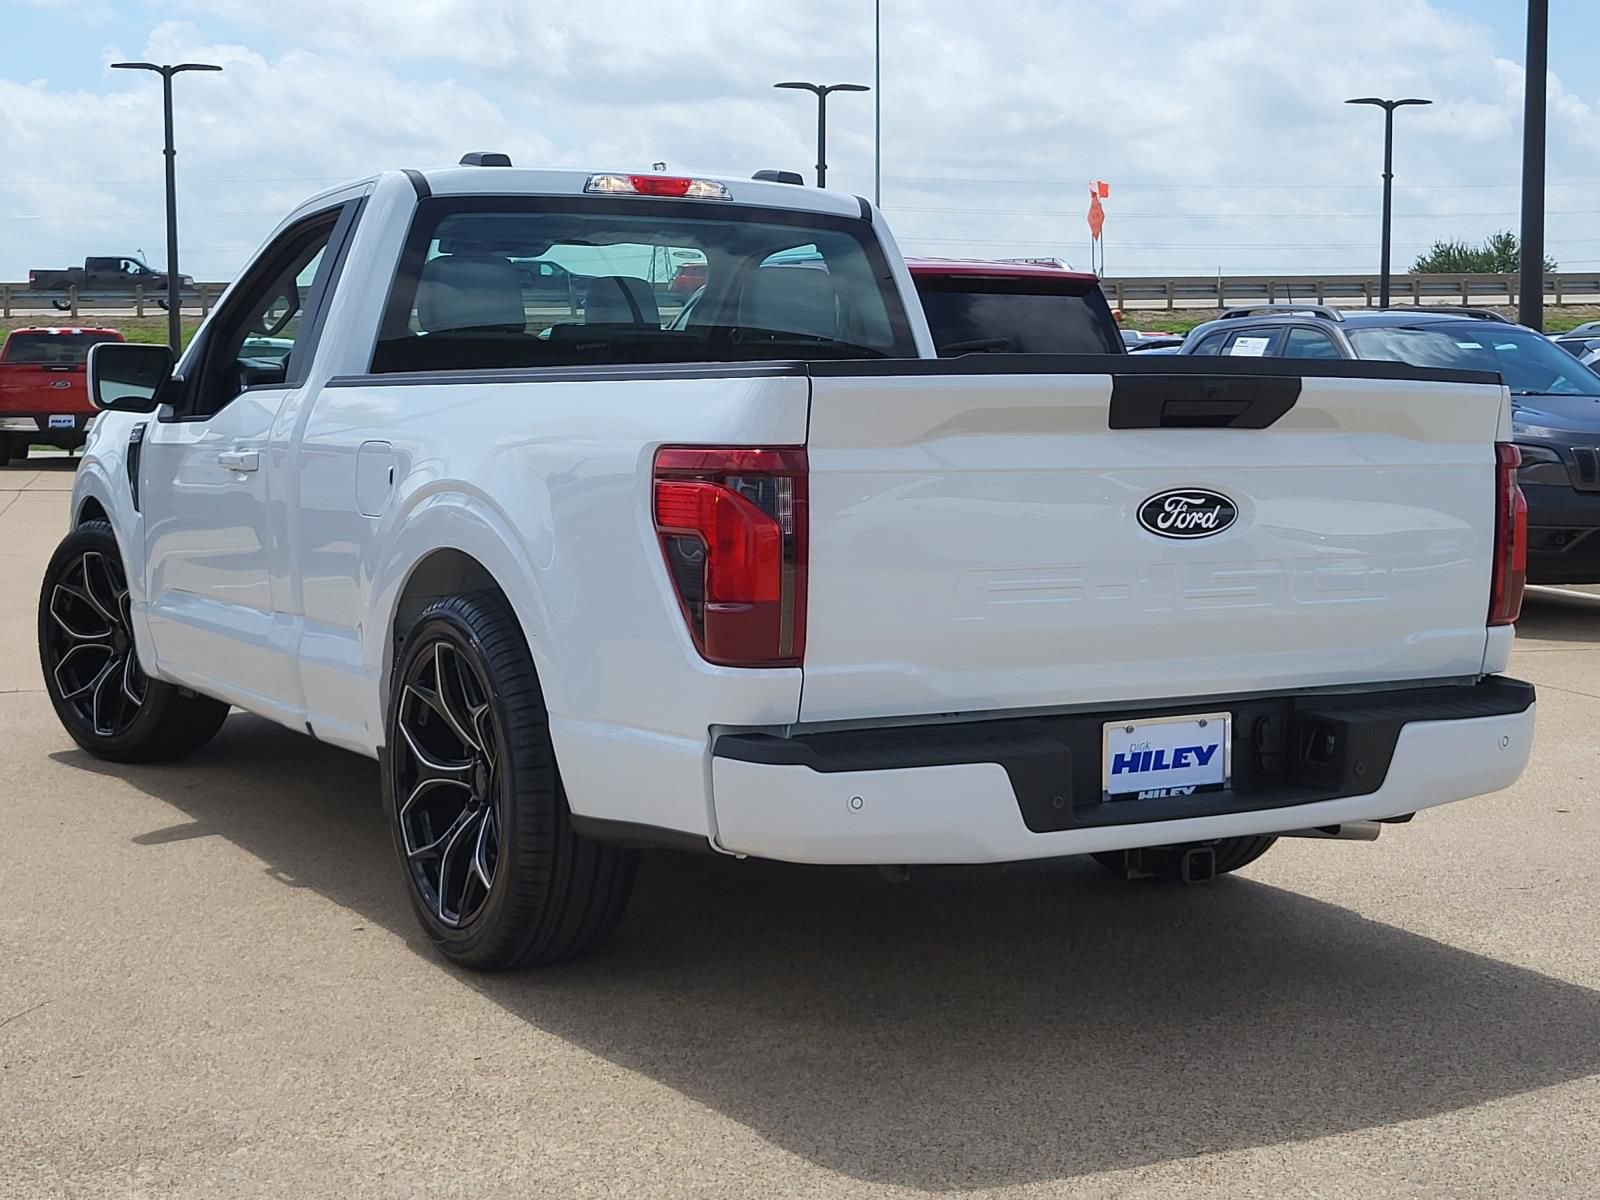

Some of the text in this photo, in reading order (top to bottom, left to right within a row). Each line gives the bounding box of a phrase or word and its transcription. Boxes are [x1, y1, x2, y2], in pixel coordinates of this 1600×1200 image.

[1157, 497, 1220, 528] Ford
[1112, 744, 1218, 774] HILEY
[1138, 786, 1197, 800] HILEY
